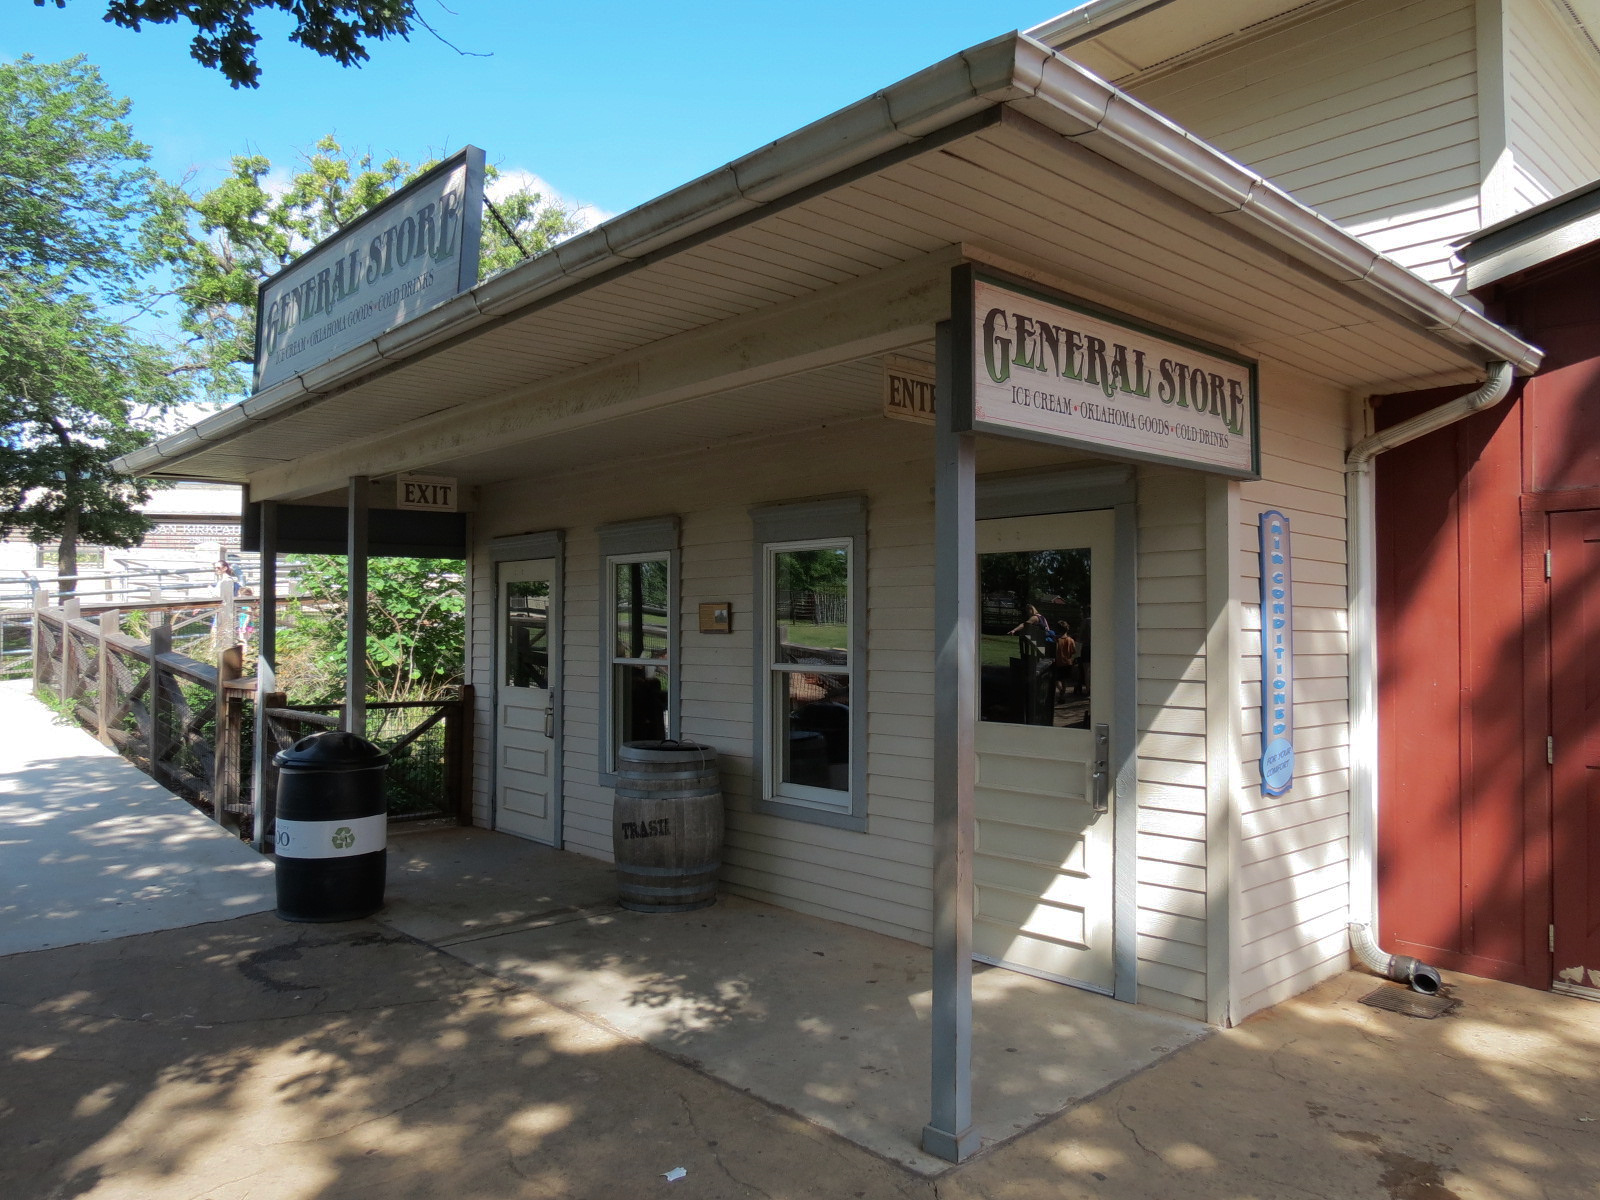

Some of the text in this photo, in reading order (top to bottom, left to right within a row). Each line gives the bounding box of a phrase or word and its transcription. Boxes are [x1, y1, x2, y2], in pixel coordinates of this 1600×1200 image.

[266, 189, 460, 356] GENERAL STORE
[286, 336, 306, 360] CREAM
[310, 316, 346, 346] OKLAHOMA
[348, 301, 373, 328] GOODS
[379, 287, 399, 312] COLD
[400, 269, 434, 301] DRINKS
[983, 308, 1244, 436] GENERAL STORE
[1012, 386, 1229, 448] ICE CREAM OKLAHOMA GOODS COLD DRINKS
[404, 482, 452, 505] EXIT
[1270, 520, 1287, 735] AIR CONDITIONED
[1266, 759, 1290, 777] COMFORT
[1267, 746, 1291, 766] FOR YOUR
[621, 818, 671, 839] TRASH
